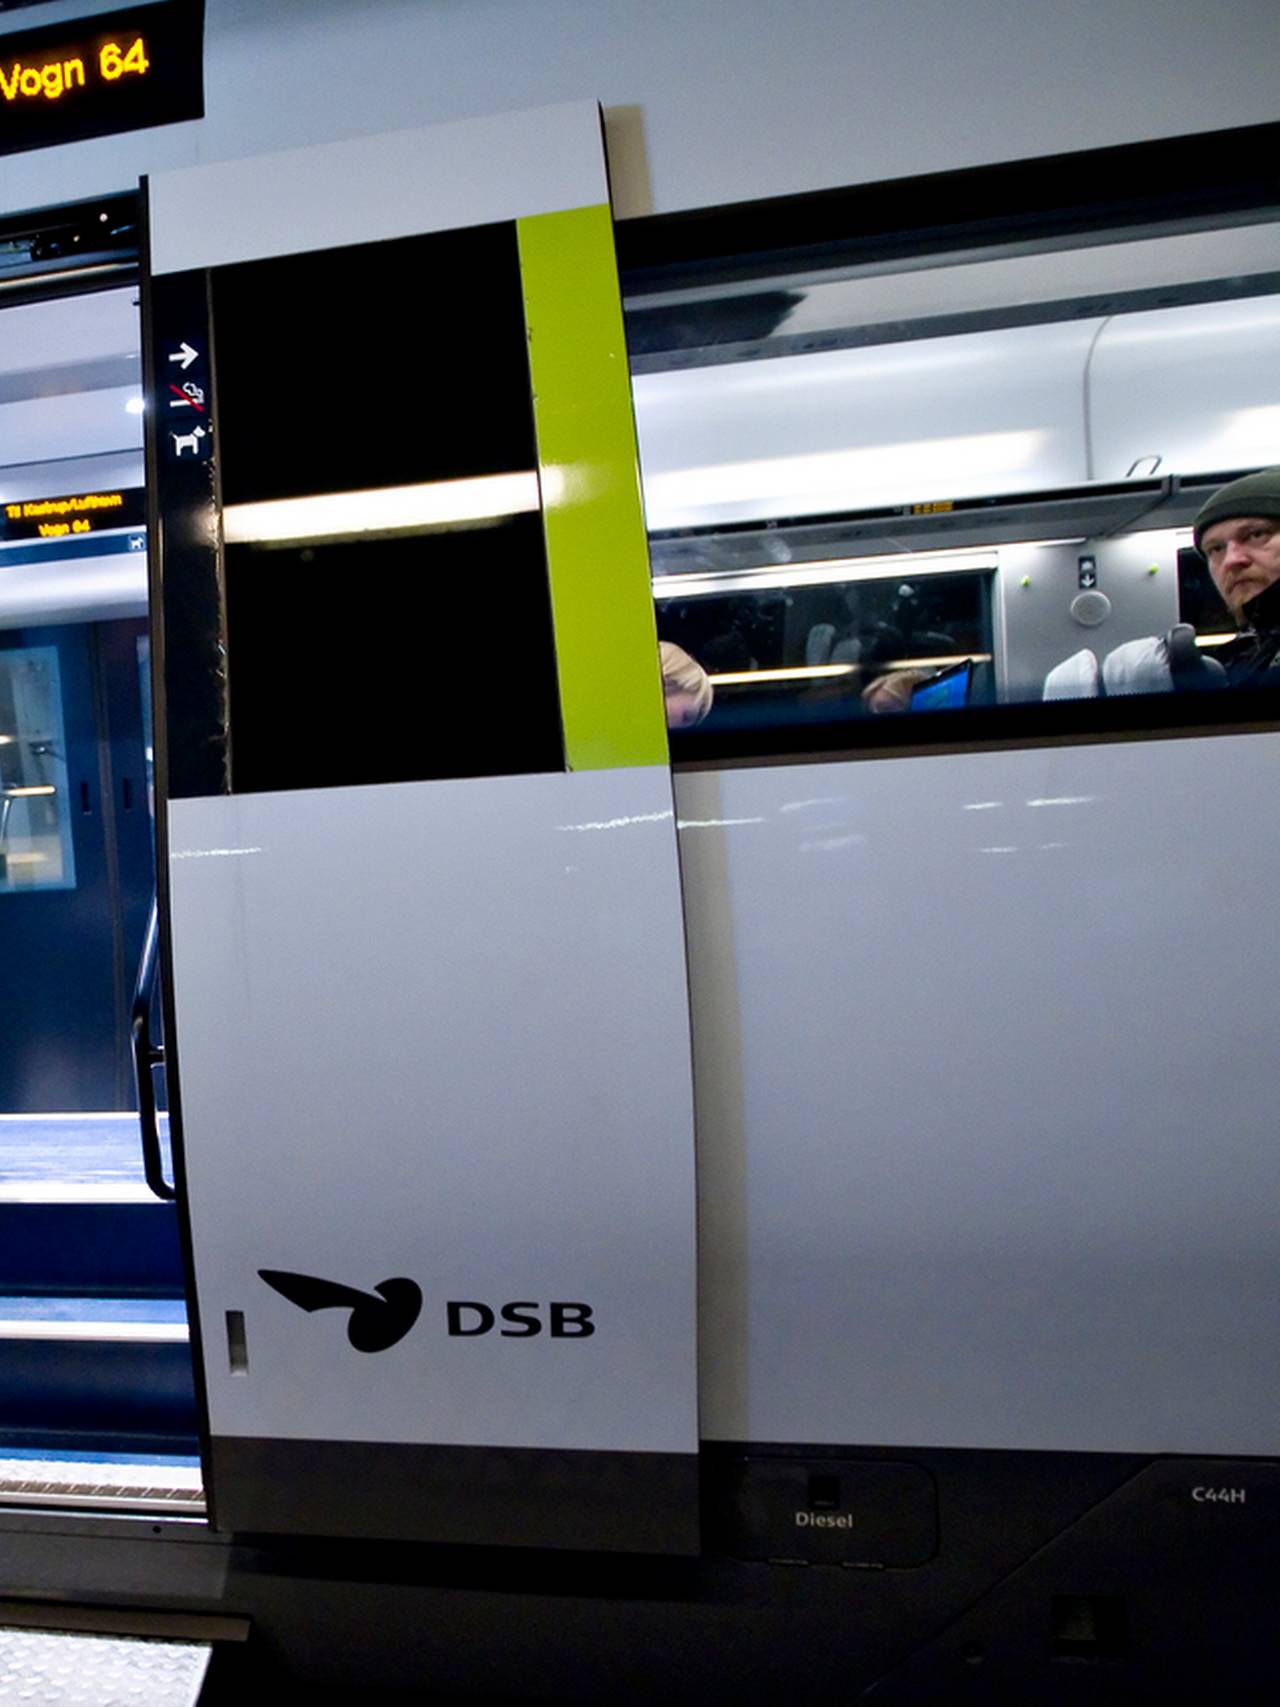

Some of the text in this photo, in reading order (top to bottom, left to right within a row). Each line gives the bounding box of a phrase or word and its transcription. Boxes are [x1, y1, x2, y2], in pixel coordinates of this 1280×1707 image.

[99, 37, 150, 82] 64
[23, 494, 123, 518] Kastrup/Lufthavn
[446, 1301, 596, 1339] DSB
[1191, 1486, 1246, 1504] C44H
[795, 1511, 854, 1529] Diesel
